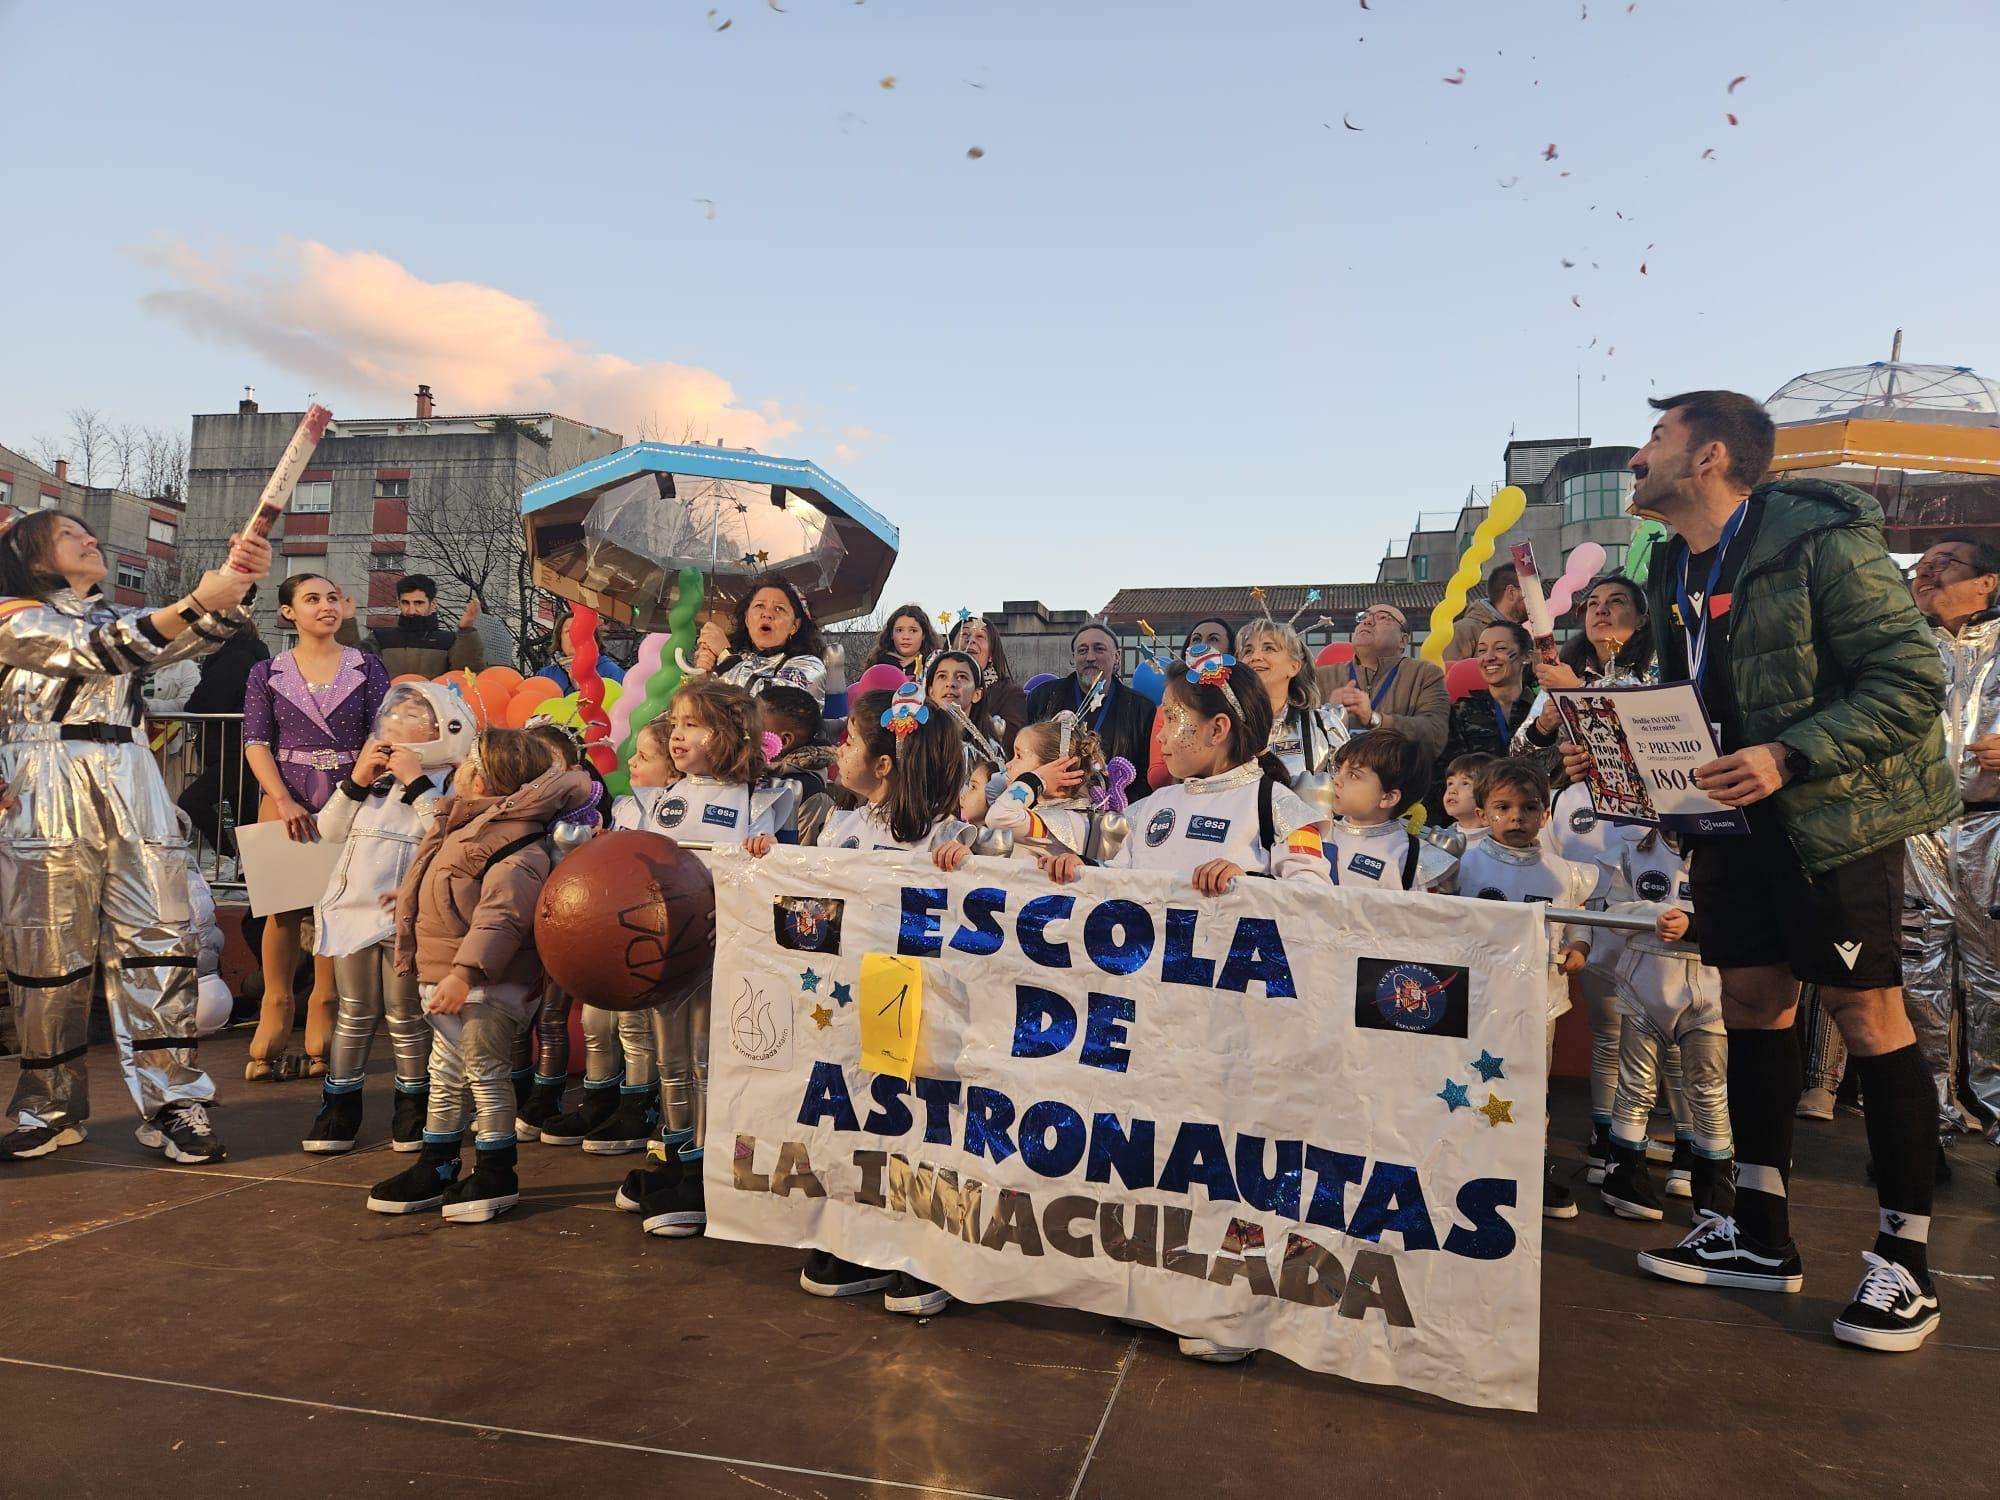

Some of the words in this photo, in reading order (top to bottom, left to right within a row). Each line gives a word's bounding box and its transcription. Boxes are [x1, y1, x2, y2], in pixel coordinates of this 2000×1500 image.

[1648, 740, 1702, 753] PREMIO
[897, 887, 1298, 999] ESCOLA
[878, 984, 908, 1038] 1
[1011, 984, 1136, 1073] DE
[797, 1061, 1517, 1260] ASTRONAUTAS
[733, 1134, 827, 1198] LA
[852, 1149, 1416, 1328] INMACULADA
